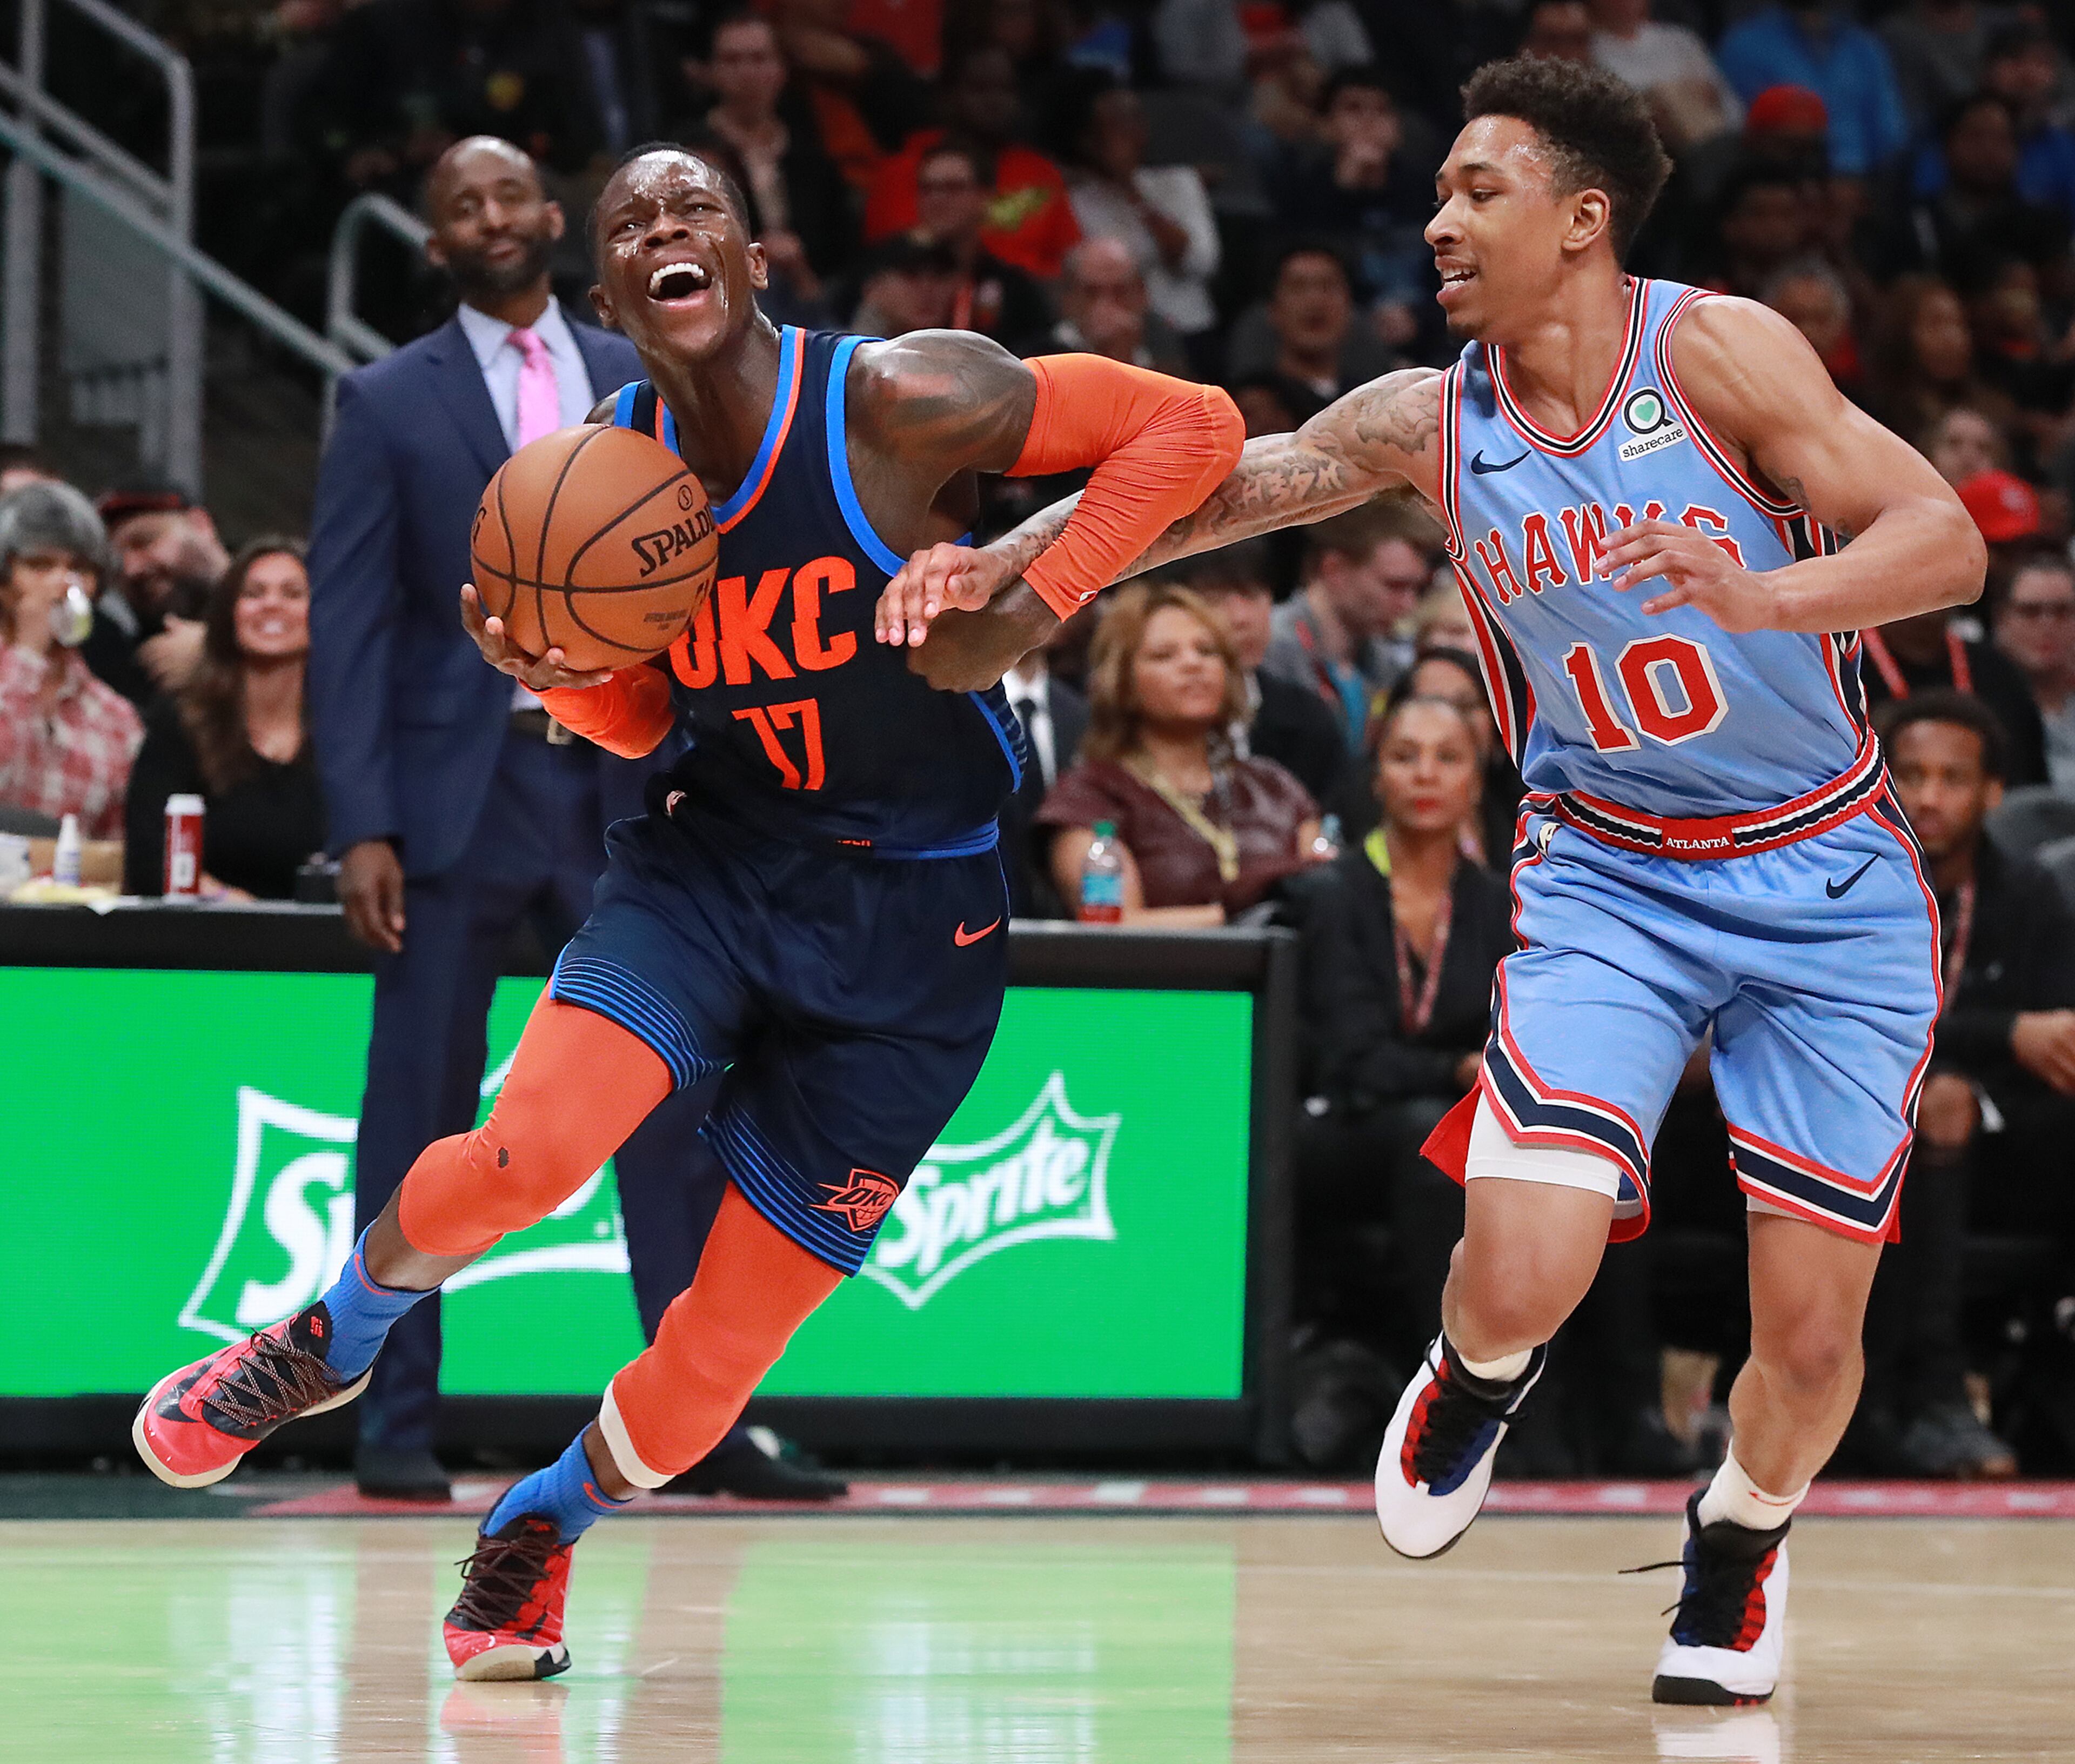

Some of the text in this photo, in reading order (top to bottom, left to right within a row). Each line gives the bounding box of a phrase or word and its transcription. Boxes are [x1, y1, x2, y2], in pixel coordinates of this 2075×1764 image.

[1622, 427, 1684, 458] sharecare
[1561, 632, 1729, 754] 10
[731, 698, 826, 791] 17
[1665, 836, 1730, 850] ATLANTA
[833, 1187, 893, 1207] OKC
[876, 1115, 1089, 1277] Sprite
